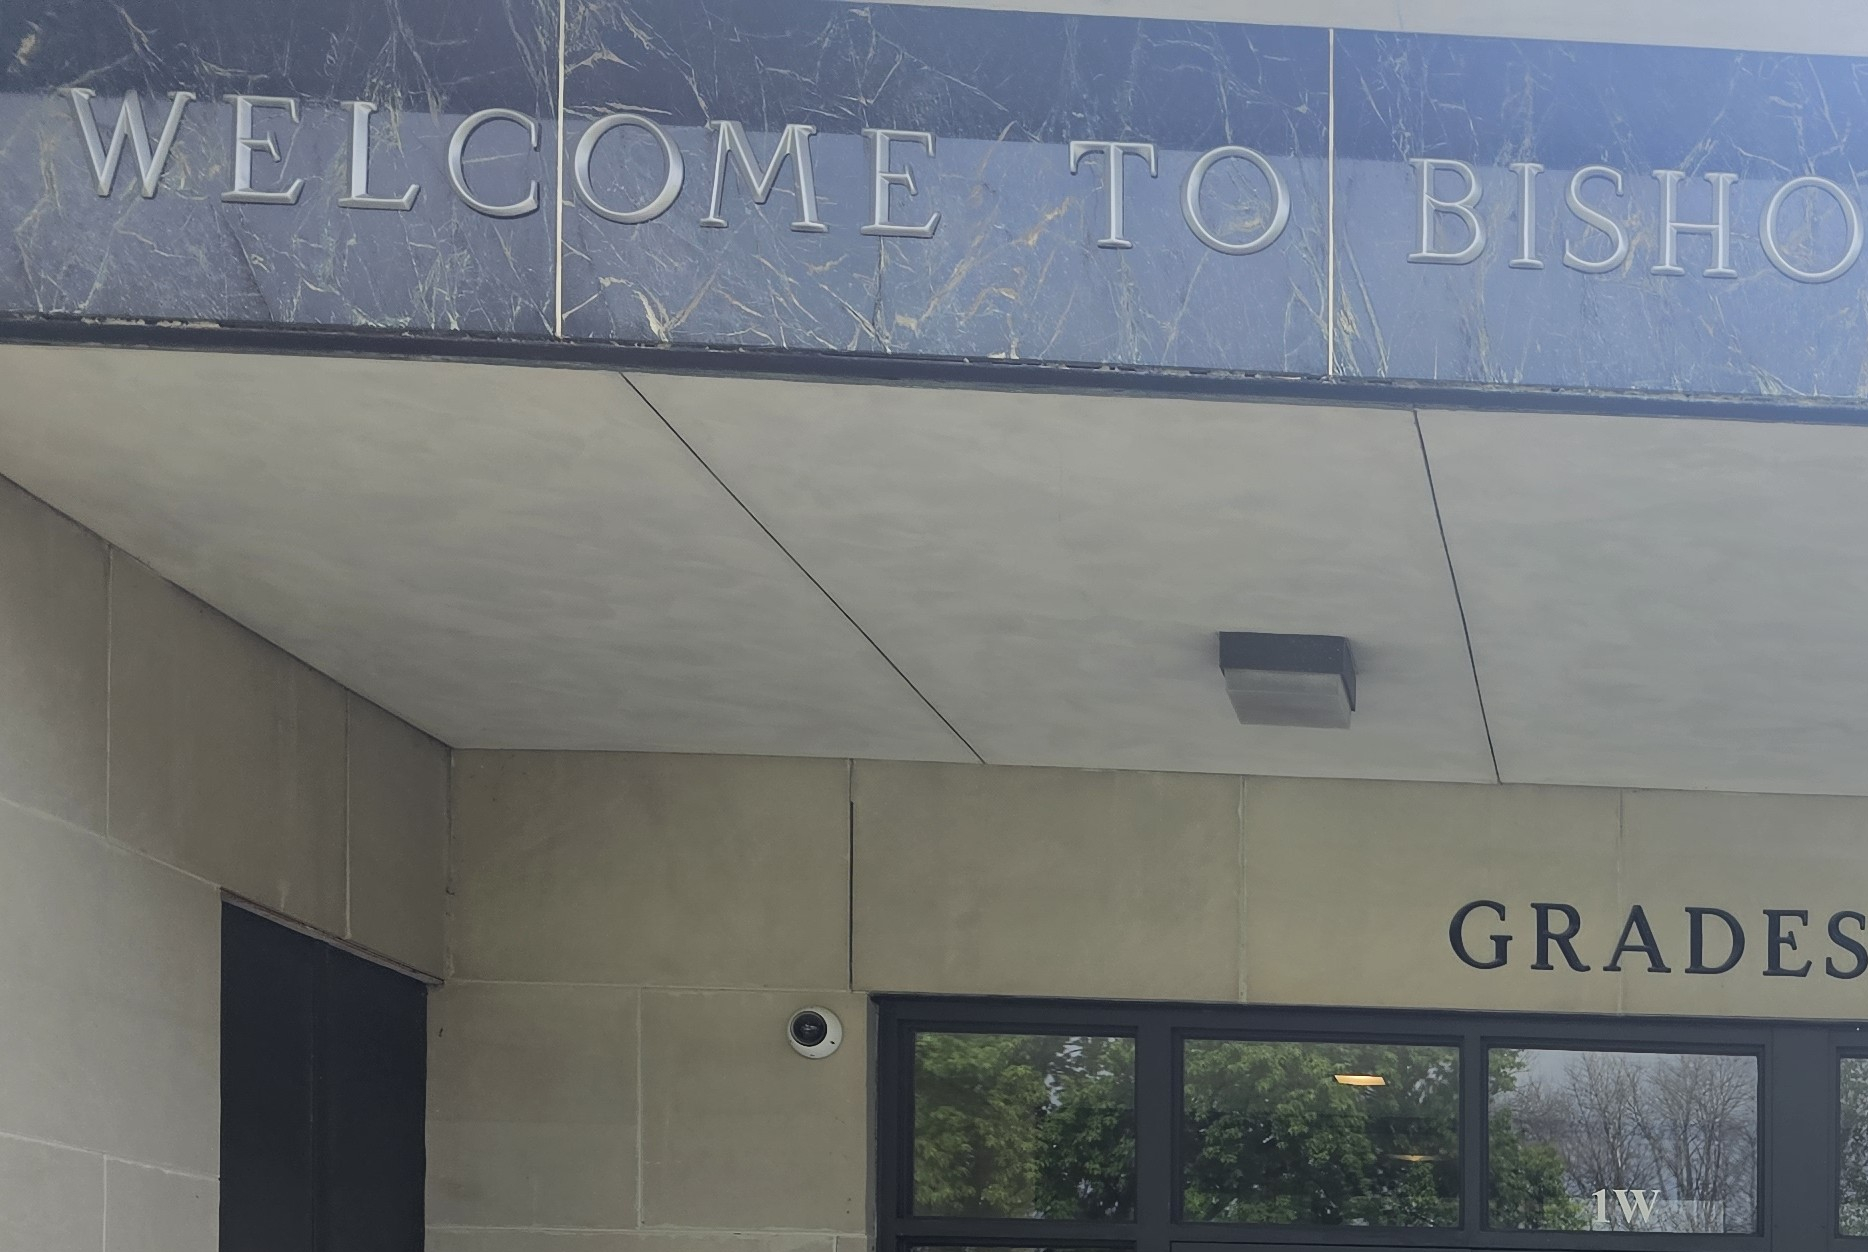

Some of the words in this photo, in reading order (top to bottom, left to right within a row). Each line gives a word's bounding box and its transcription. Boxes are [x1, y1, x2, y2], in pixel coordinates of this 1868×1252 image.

[59, 86, 941, 240] WELCOME
[1069, 139, 1291, 255] TO
[1592, 1188, 1659, 1224] 1W
